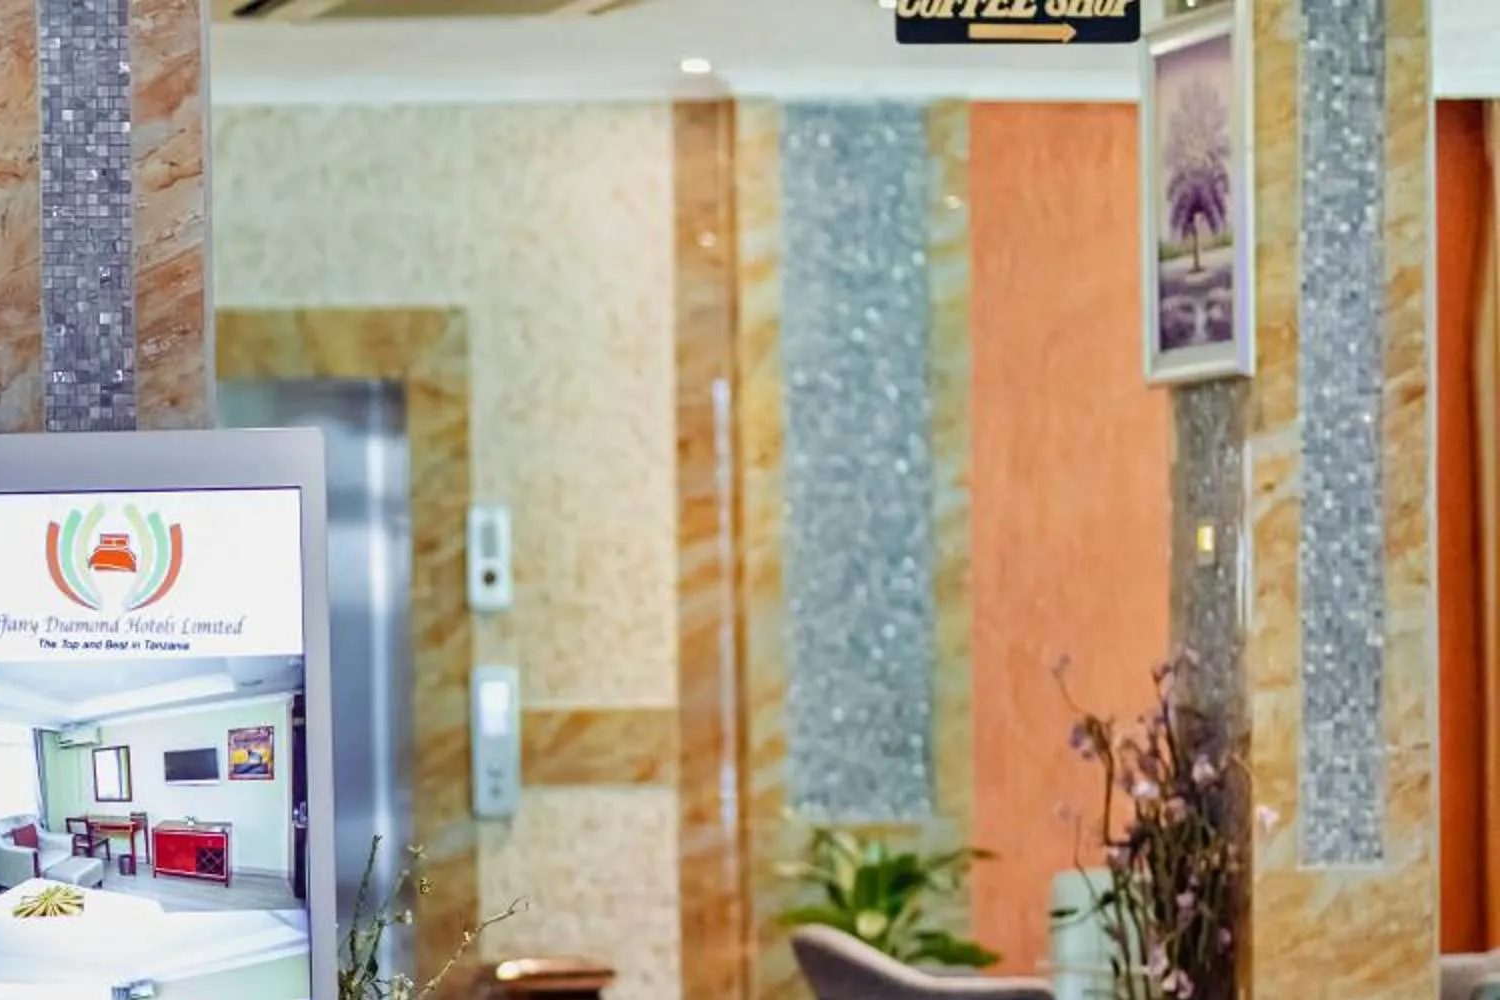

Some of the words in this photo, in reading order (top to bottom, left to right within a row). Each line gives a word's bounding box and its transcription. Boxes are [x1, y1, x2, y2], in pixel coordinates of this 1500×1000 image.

[45, 614, 122, 633] Diamond
[126, 614, 177, 635] Hotels
[181, 615, 246, 635] Limited
[39, 638, 57, 649] The
[61, 639, 80, 651] Top
[82, 639, 102, 650] and
[105, 639, 129, 650] Best
